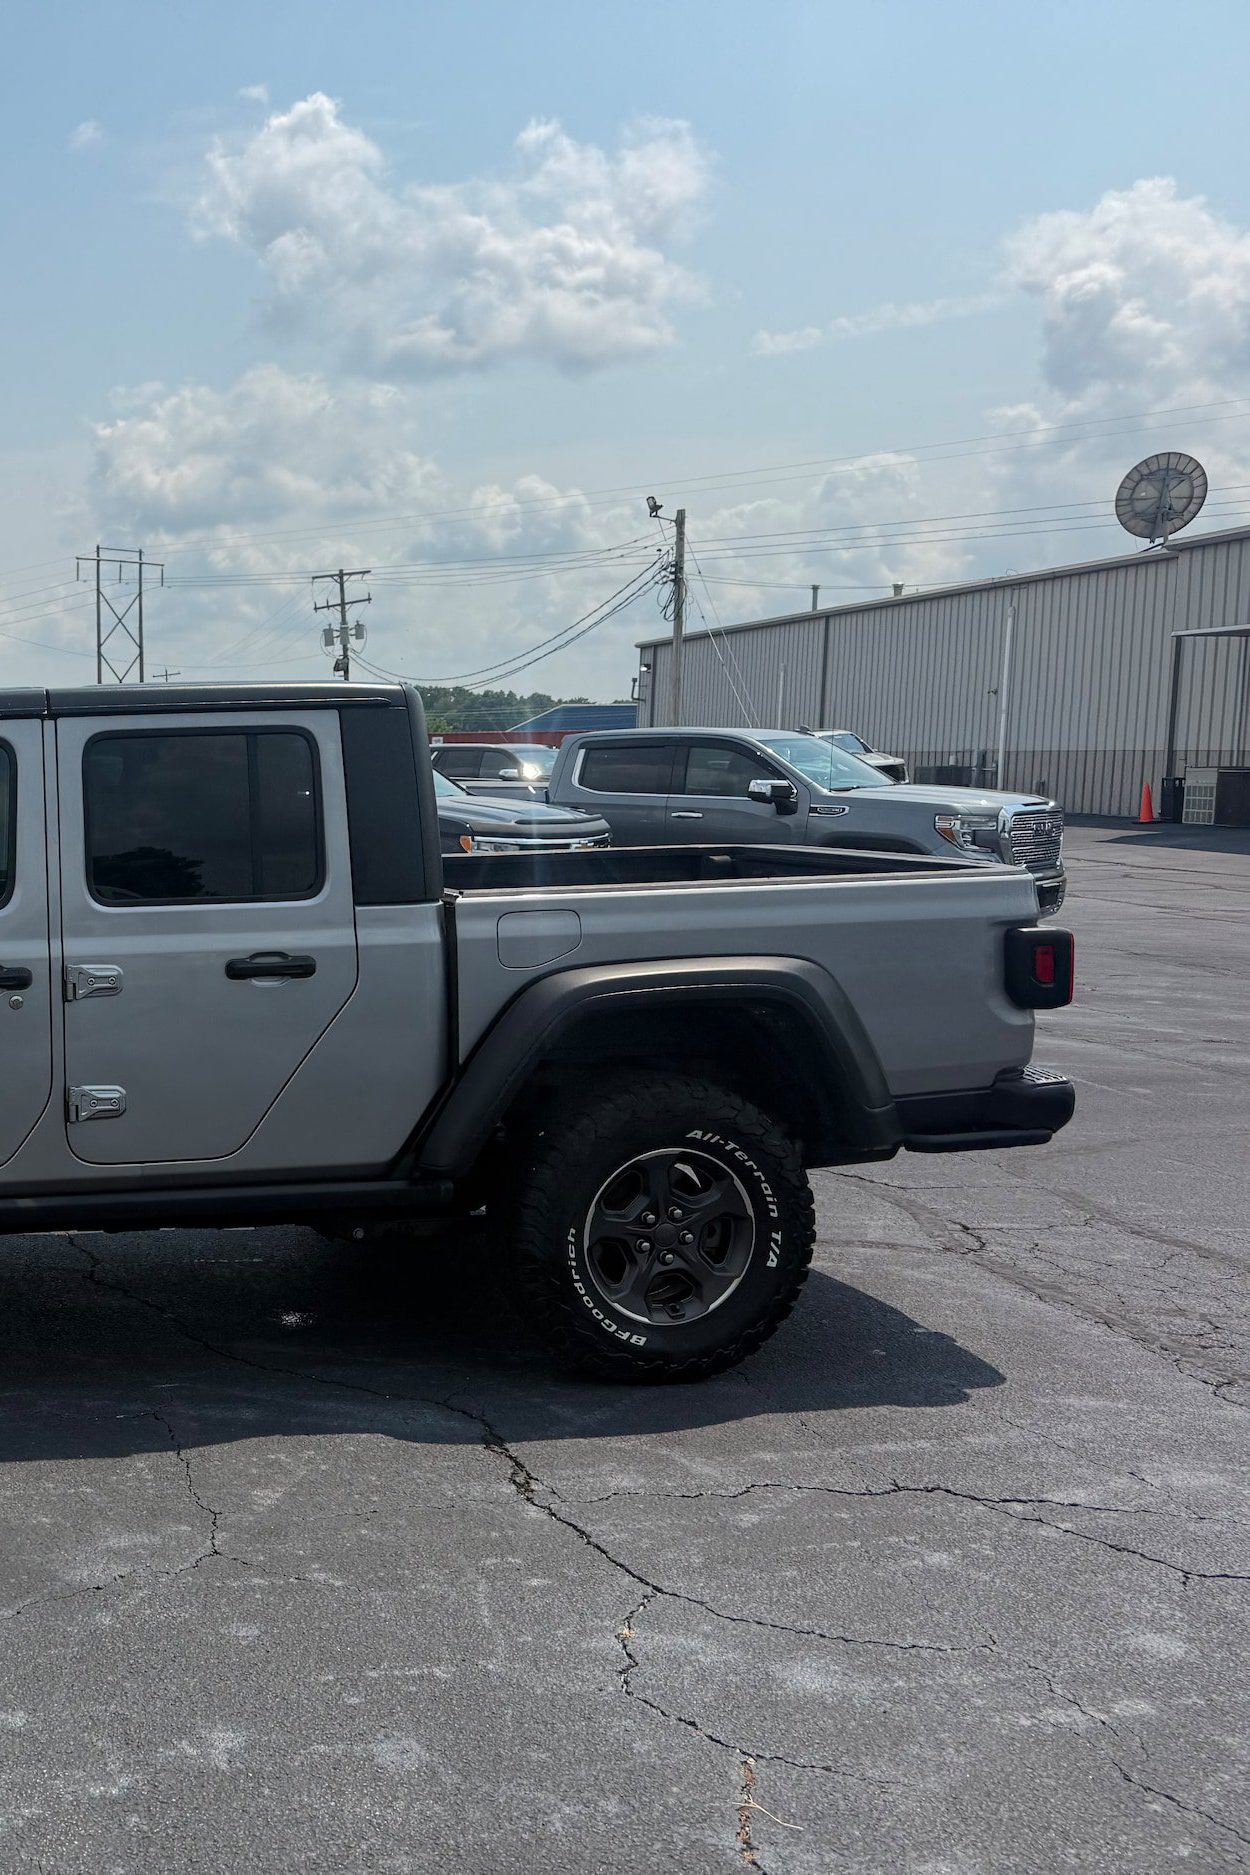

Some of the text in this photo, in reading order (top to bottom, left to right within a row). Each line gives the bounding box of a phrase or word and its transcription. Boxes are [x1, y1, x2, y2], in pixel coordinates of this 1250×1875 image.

[686, 1130, 783, 1268] All-Terrain T/A
[566, 1227, 648, 1346] BFGoodrich
